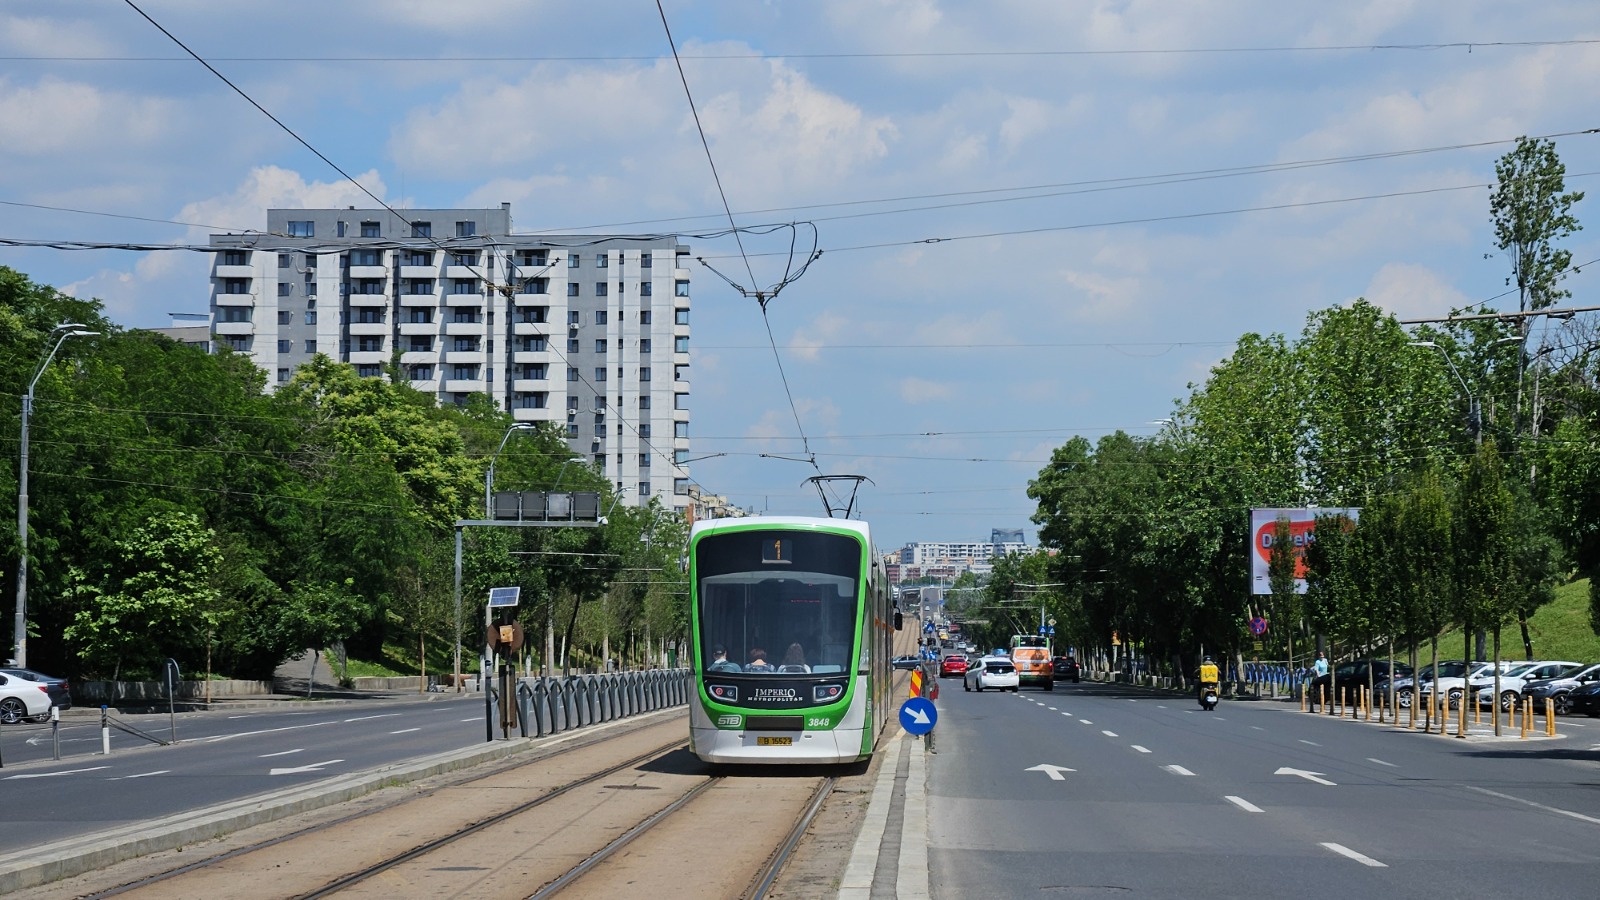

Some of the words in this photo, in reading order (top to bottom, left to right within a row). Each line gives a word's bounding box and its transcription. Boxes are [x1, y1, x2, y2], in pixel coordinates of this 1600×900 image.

[774, 539, 781, 561] 1
[755, 688, 795, 697] IMPERIO
[718, 716, 740, 725] STB
[808, 718, 829, 726] 3848
